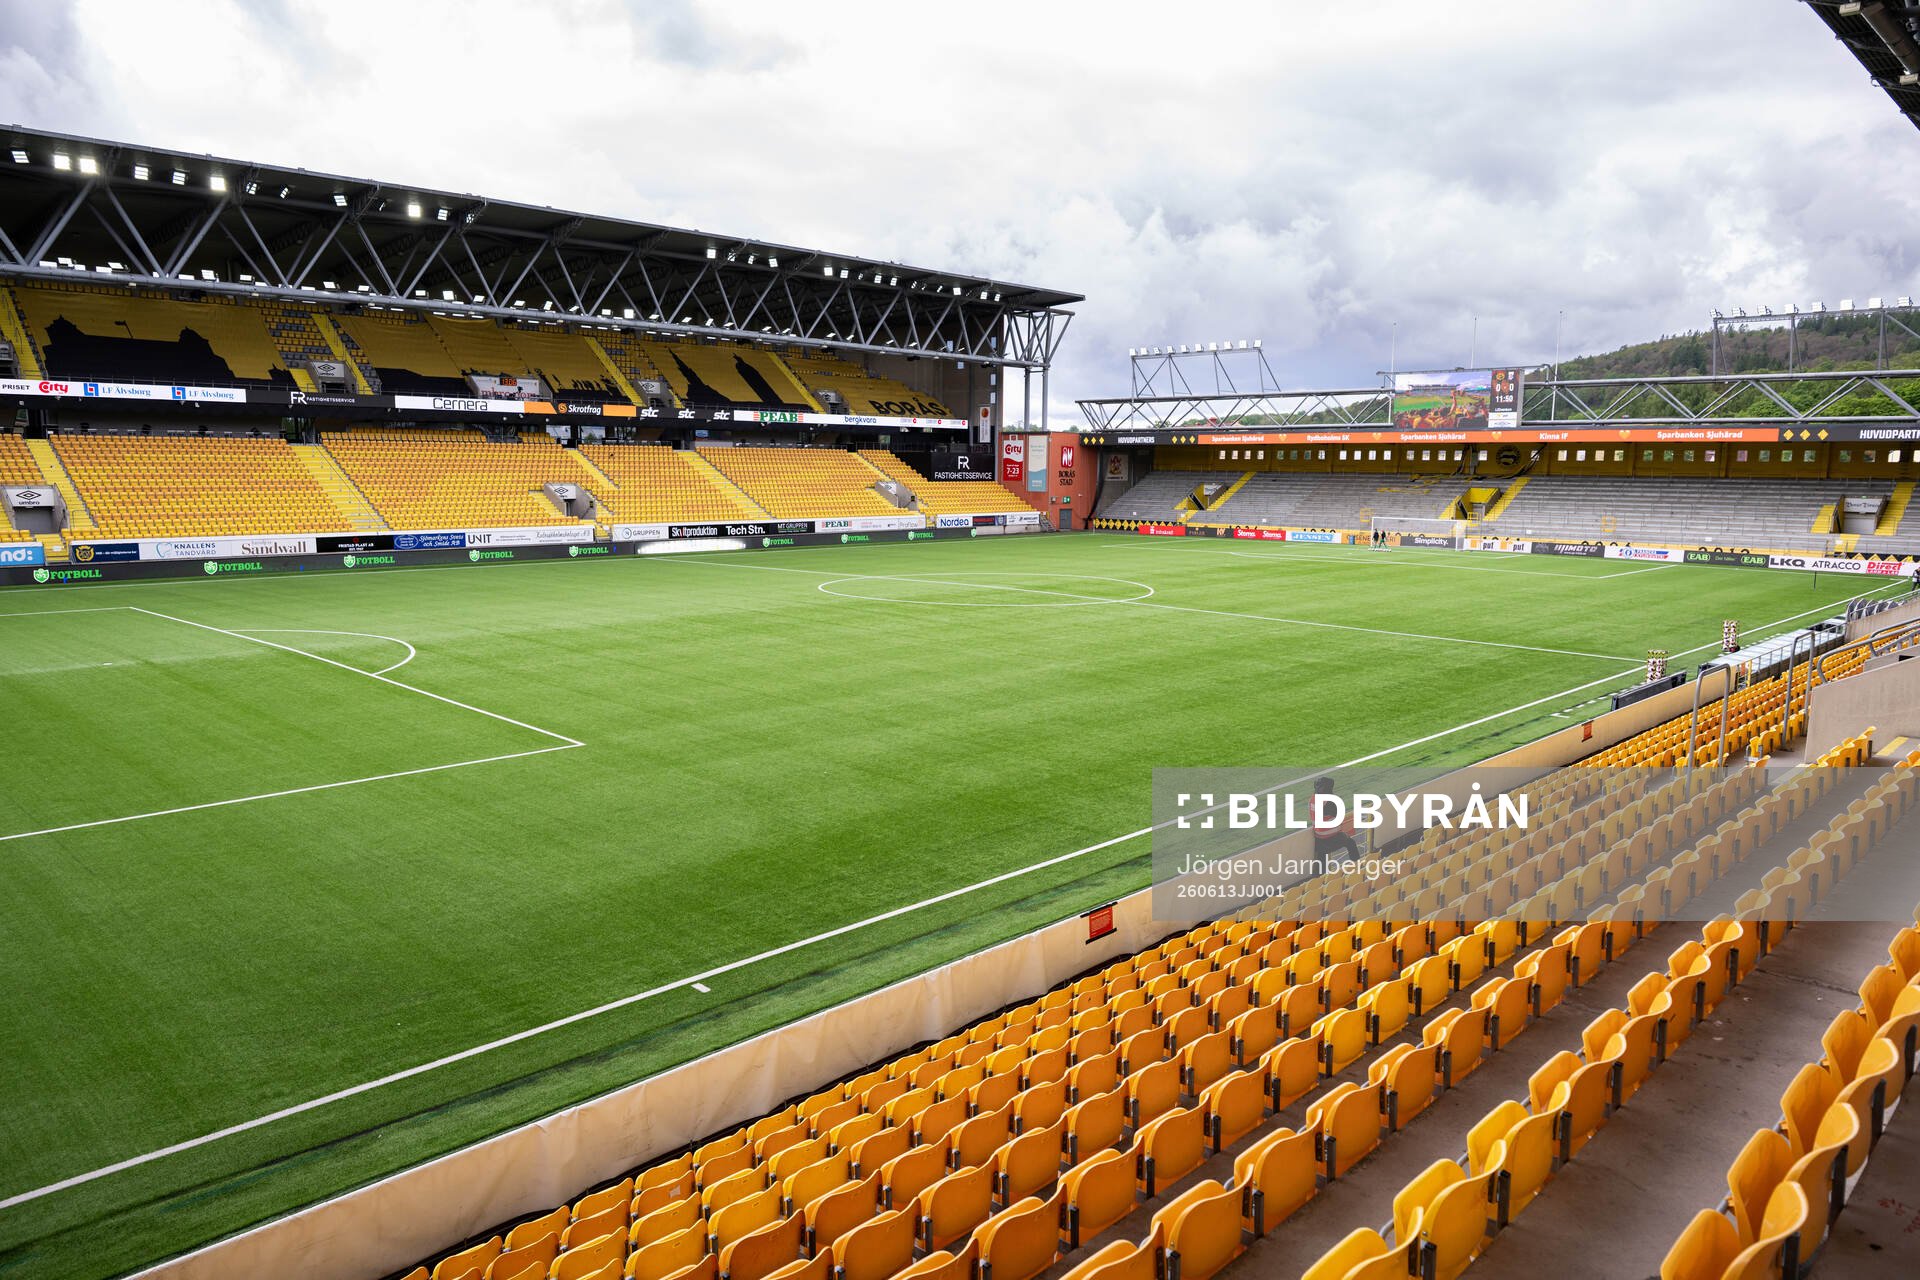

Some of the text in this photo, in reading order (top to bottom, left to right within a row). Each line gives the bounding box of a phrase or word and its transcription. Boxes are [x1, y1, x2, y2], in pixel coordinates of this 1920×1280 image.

[39, 381, 68, 394] City
[115, 386, 151, 396] Älvsborg
[433, 397, 488, 411] Cernera
[869, 397, 947, 416] BORÅS
[568, 404, 601, 415] Skrotfrag
[641, 407, 659, 418] stc
[678, 408, 695, 419] stc
[713, 410, 730, 420] stc
[759, 411, 798, 423] PEAB
[845, 416, 877, 424] bergkvara
[1400, 433, 1437, 441] Sparbanken
[1540, 432, 1559, 440] Kinna
[1657, 430, 1743, 440] Sparbanken Sjuhärad
[1005, 444, 1022, 455] City
[934, 471, 992, 480] FASTIGHETSSERVICE
[1058, 469, 1076, 478] BORÅS
[825, 520, 849, 528] PEAB
[940, 518, 969, 527] Nordea
[671, 526, 718, 538] Skyltproduktion
[725, 525, 766, 536] Tech Stn.
[468, 534, 492, 544] UNIT
[174, 542, 216, 550] KNALLENS
[242, 541, 306, 554] Sandwall
[579, 546, 609, 554] FOTBOLL
[175, 548, 217, 556] TANDVÅRD
[480, 551, 514, 559] FOTBOLL
[1688, 553, 1709, 561] EAB
[356, 556, 396, 565] FOTBOLL
[1743, 556, 1764, 564] EAB
[1770, 558, 1806, 568] LKQ
[219, 562, 263, 571] FOTBOLL
[1812, 561, 1861, 571] ATRACCO
[50, 569, 102, 580] FOTBOLL
